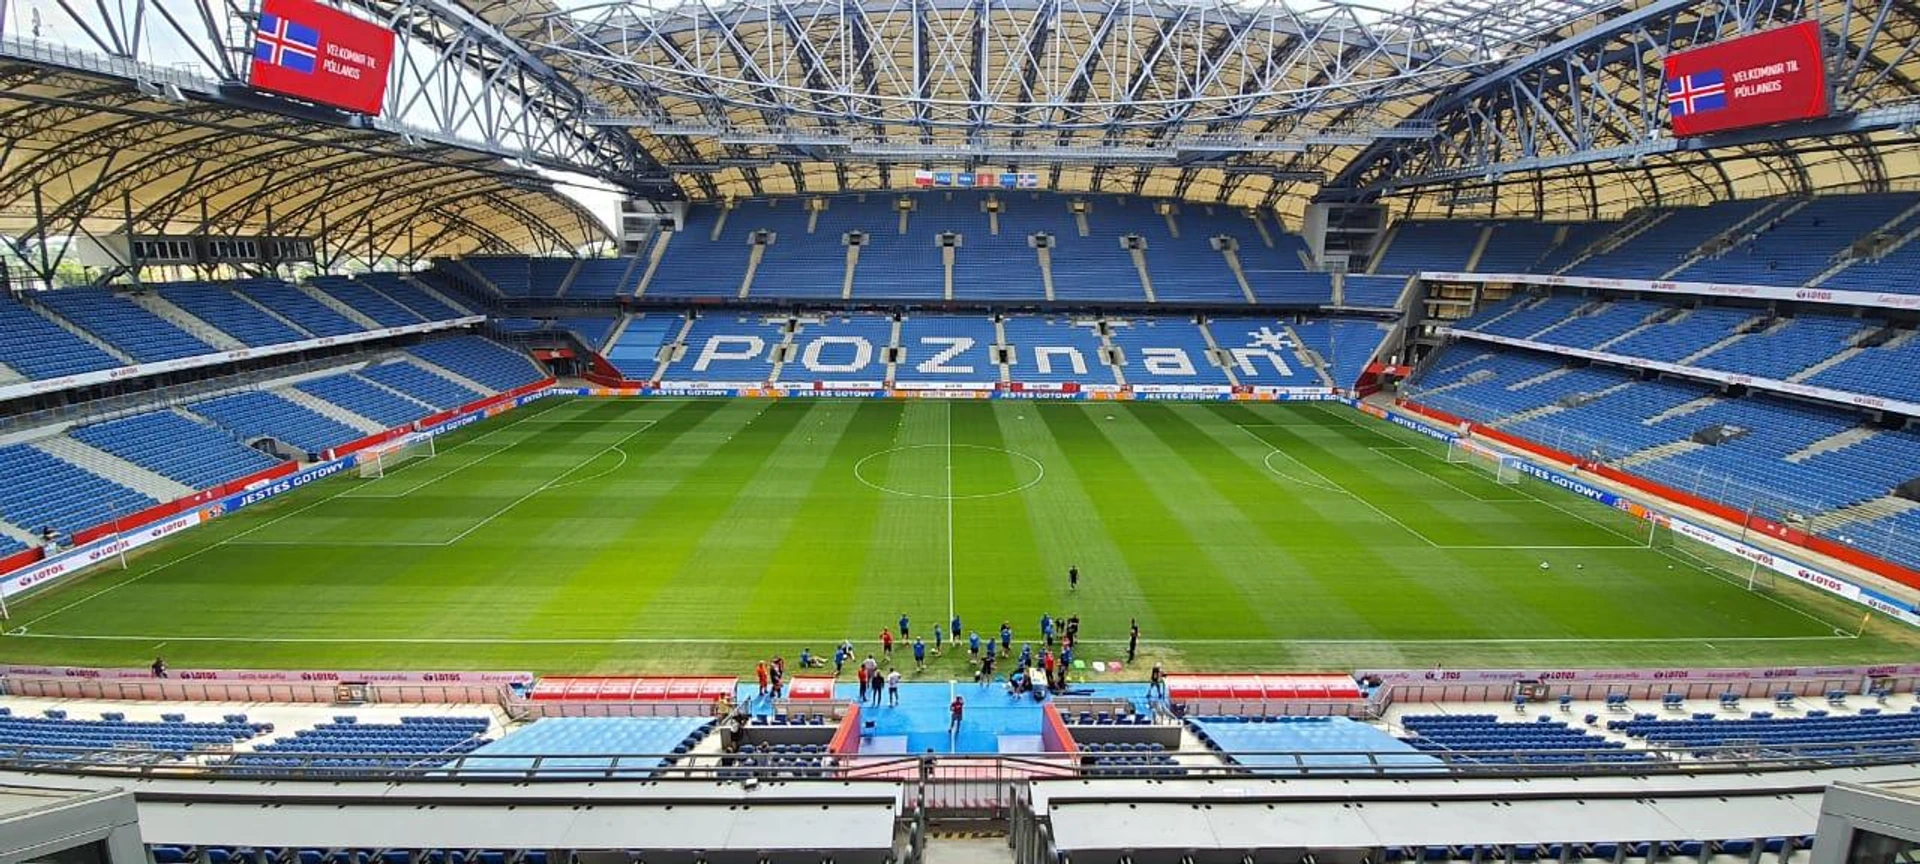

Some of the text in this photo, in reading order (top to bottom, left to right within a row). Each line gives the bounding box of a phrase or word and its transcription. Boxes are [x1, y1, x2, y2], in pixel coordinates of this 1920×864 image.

[1732, 60, 1800, 83] VELKOMNIR TIL
[293, 461, 345, 486] GOTOWY
[1551, 475, 1603, 500] GOTOWY
[163, 519, 188, 533] LOTOS
[33, 563, 64, 581] LOTOS
[1811, 572, 1842, 592] LOTOS
[1877, 601, 1901, 616] LOTOS
[192, 671, 217, 680] LOTOS
[311, 672, 339, 681] LOTOS
[434, 673, 461, 682] LOTOS
[1551, 671, 1575, 680] LOTOS
[1664, 670, 1688, 678] LOTOS
